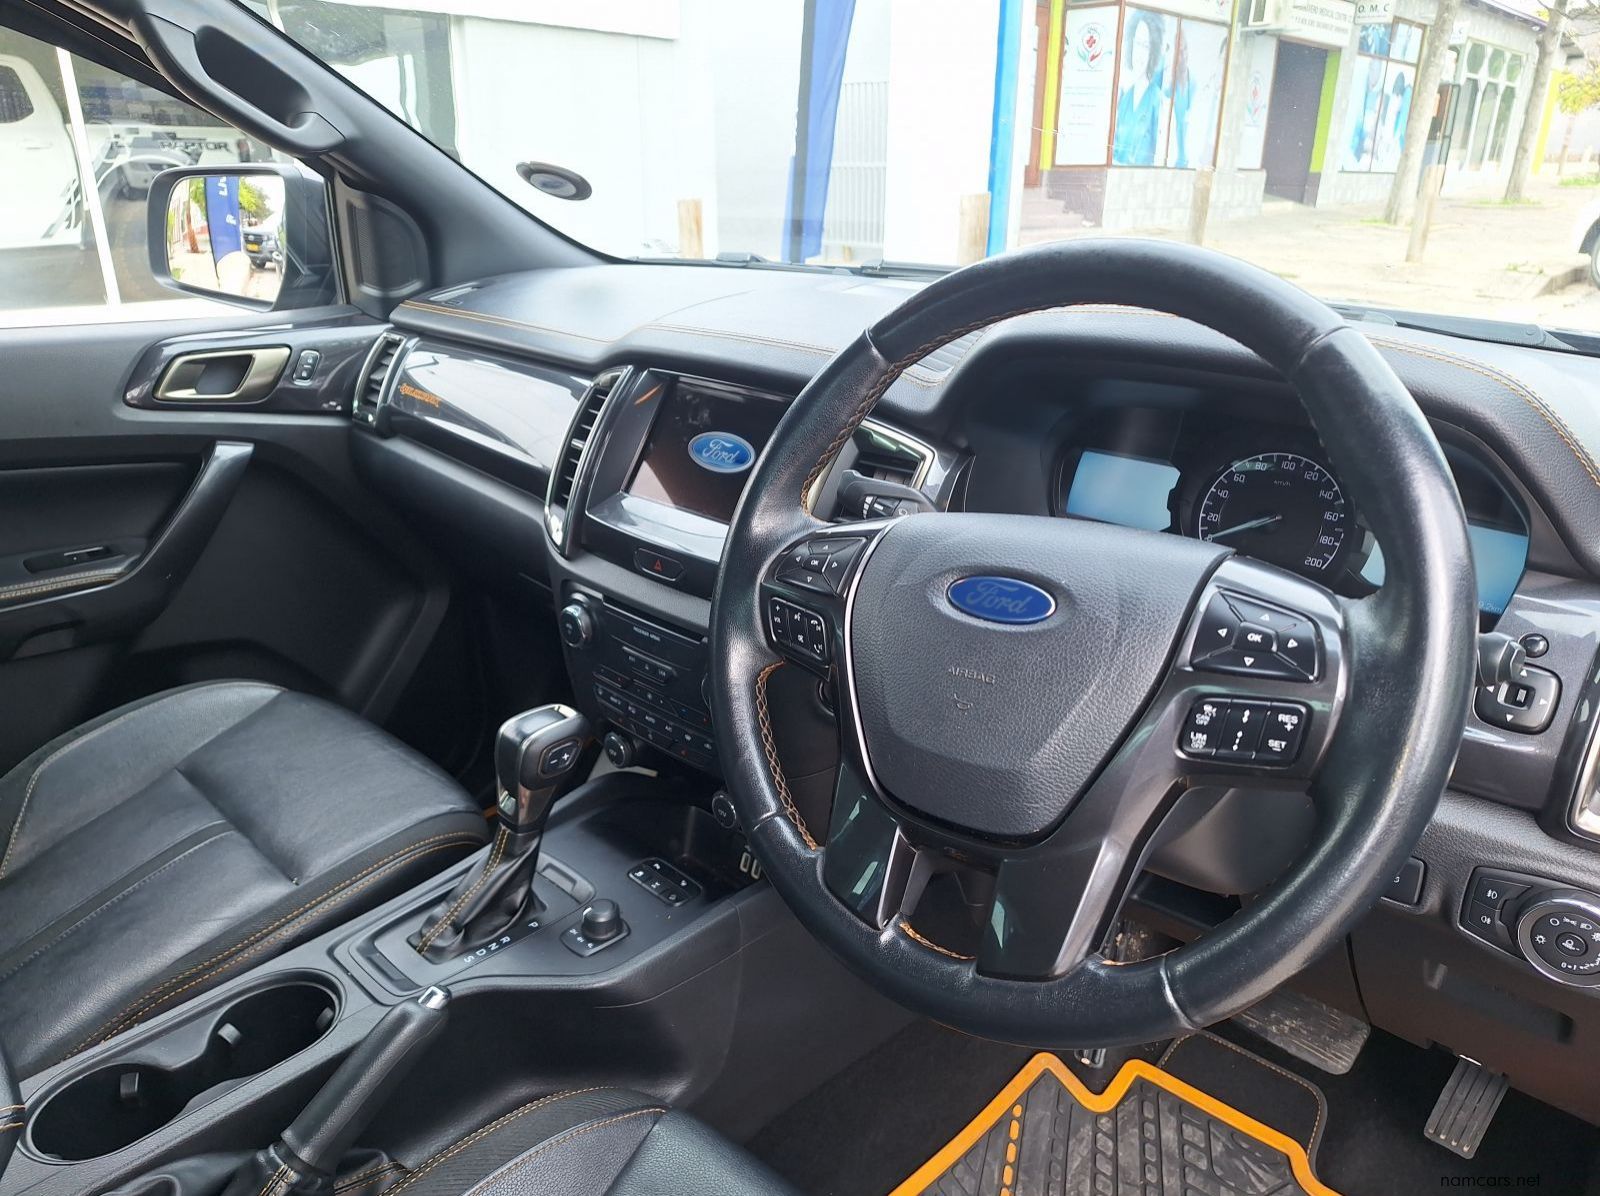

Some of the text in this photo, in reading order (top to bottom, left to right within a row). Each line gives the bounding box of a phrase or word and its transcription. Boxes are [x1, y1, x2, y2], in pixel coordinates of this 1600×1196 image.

[702, 438, 741, 465] Ford
[1255, 462, 1268, 471] 80
[1281, 462, 1296, 471] 100
[1233, 473, 1245, 483] 60
[1304, 470, 1319, 481] 120
[1217, 489, 1229, 498] 40
[1319, 490, 1334, 500] 140
[1206, 512, 1219, 522] 20
[1323, 511, 1339, 522] 160
[1319, 535, 1334, 546] 180
[810, 559, 819, 567] OK
[1304, 556, 1323, 568] 200
[966, 581, 1033, 614] Ford
[1246, 633, 1262, 643] OK
[948, 665, 996, 685] AIRBAG
[1277, 713, 1298, 725] RES
[1190, 731, 1207, 740] LIM
[1267, 739, 1287, 749] SET
[499, 935, 511, 944] R
[488, 942, 500, 951] N
[475, 948, 487, 956] D
[463, 955, 475, 963] S
